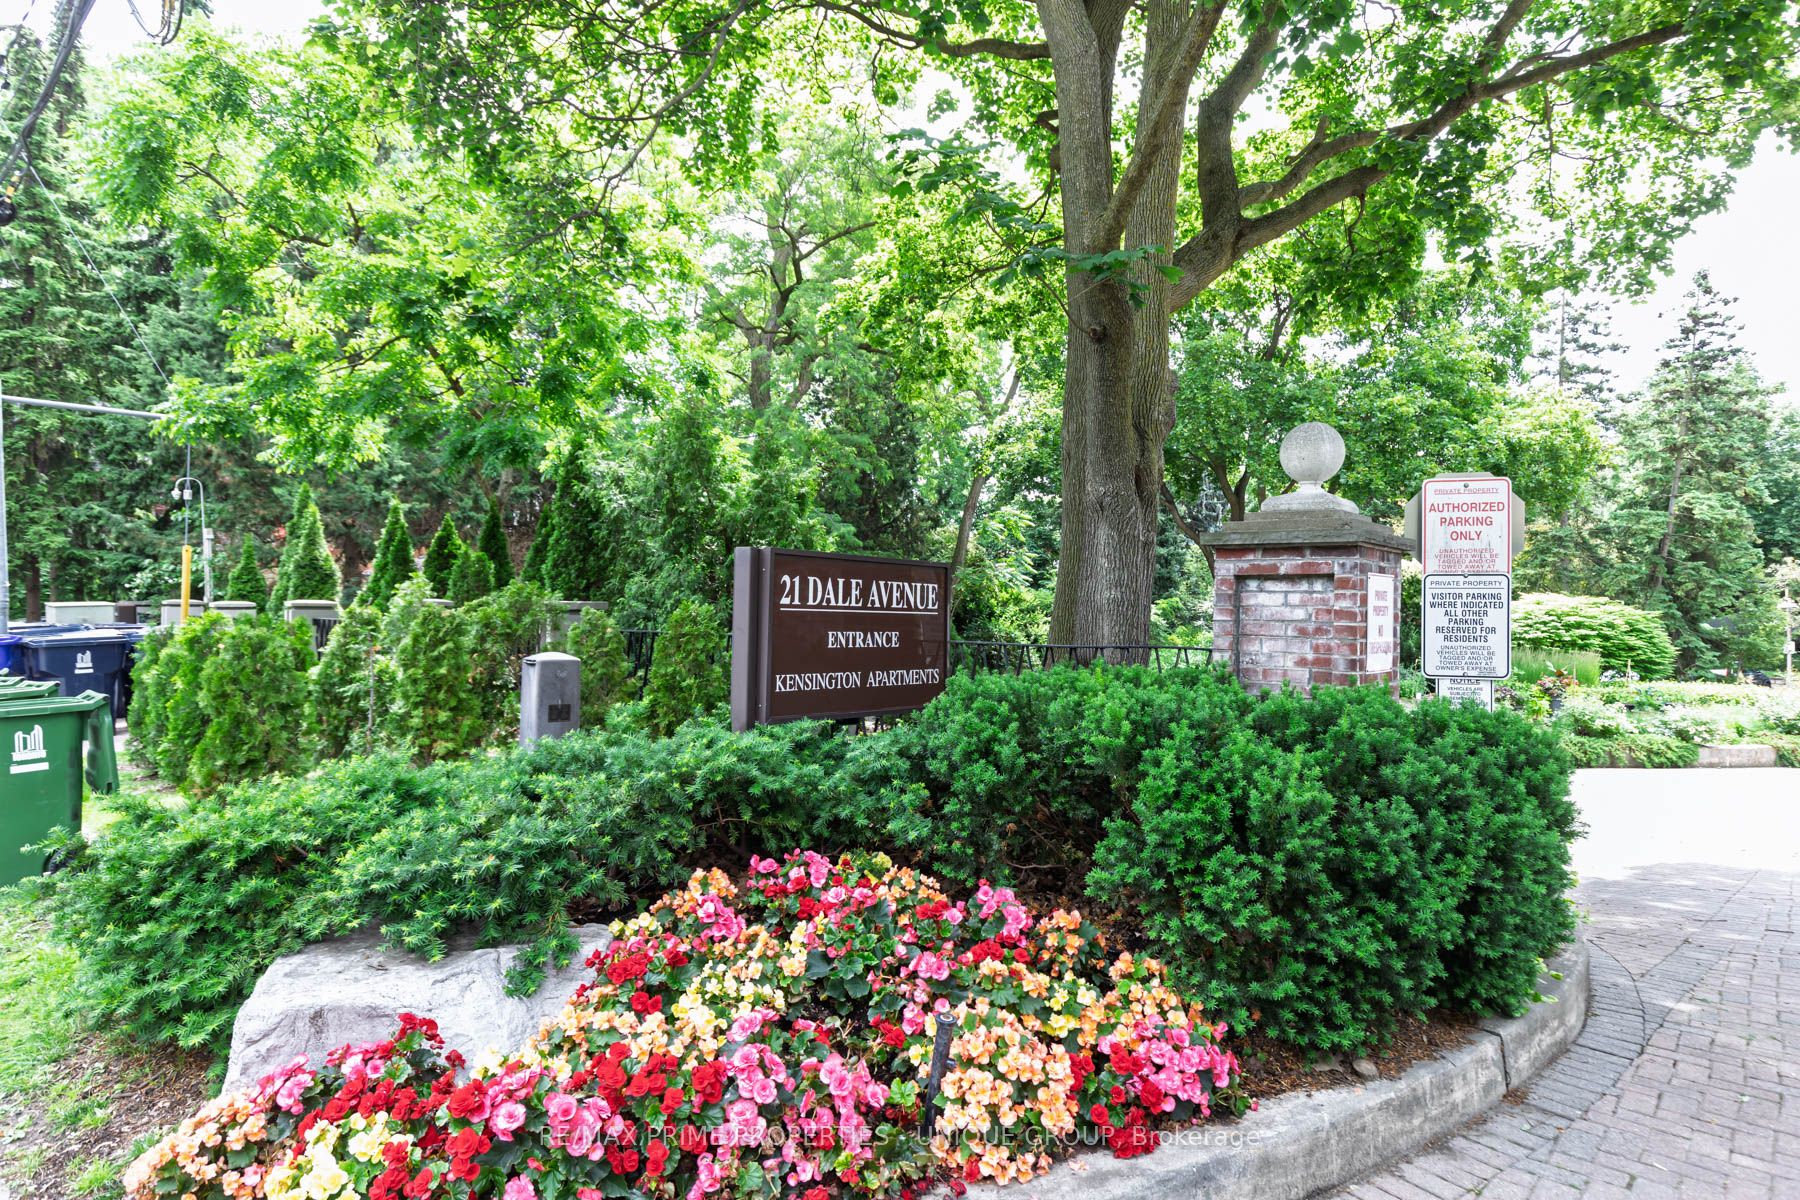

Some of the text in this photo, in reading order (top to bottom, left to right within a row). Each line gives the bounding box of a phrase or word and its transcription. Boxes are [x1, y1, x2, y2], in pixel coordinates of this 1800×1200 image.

[1429, 502, 1505, 512] AUTHORIZED
[1440, 516, 1493, 526] PARKING
[1450, 531, 1482, 540] ONLY
[780, 574, 938, 609] 21 DALE AVENUE
[828, 631, 900, 648] ENTRANCE
[775, 668, 939, 692] KENSINGTON APARTMENTS
